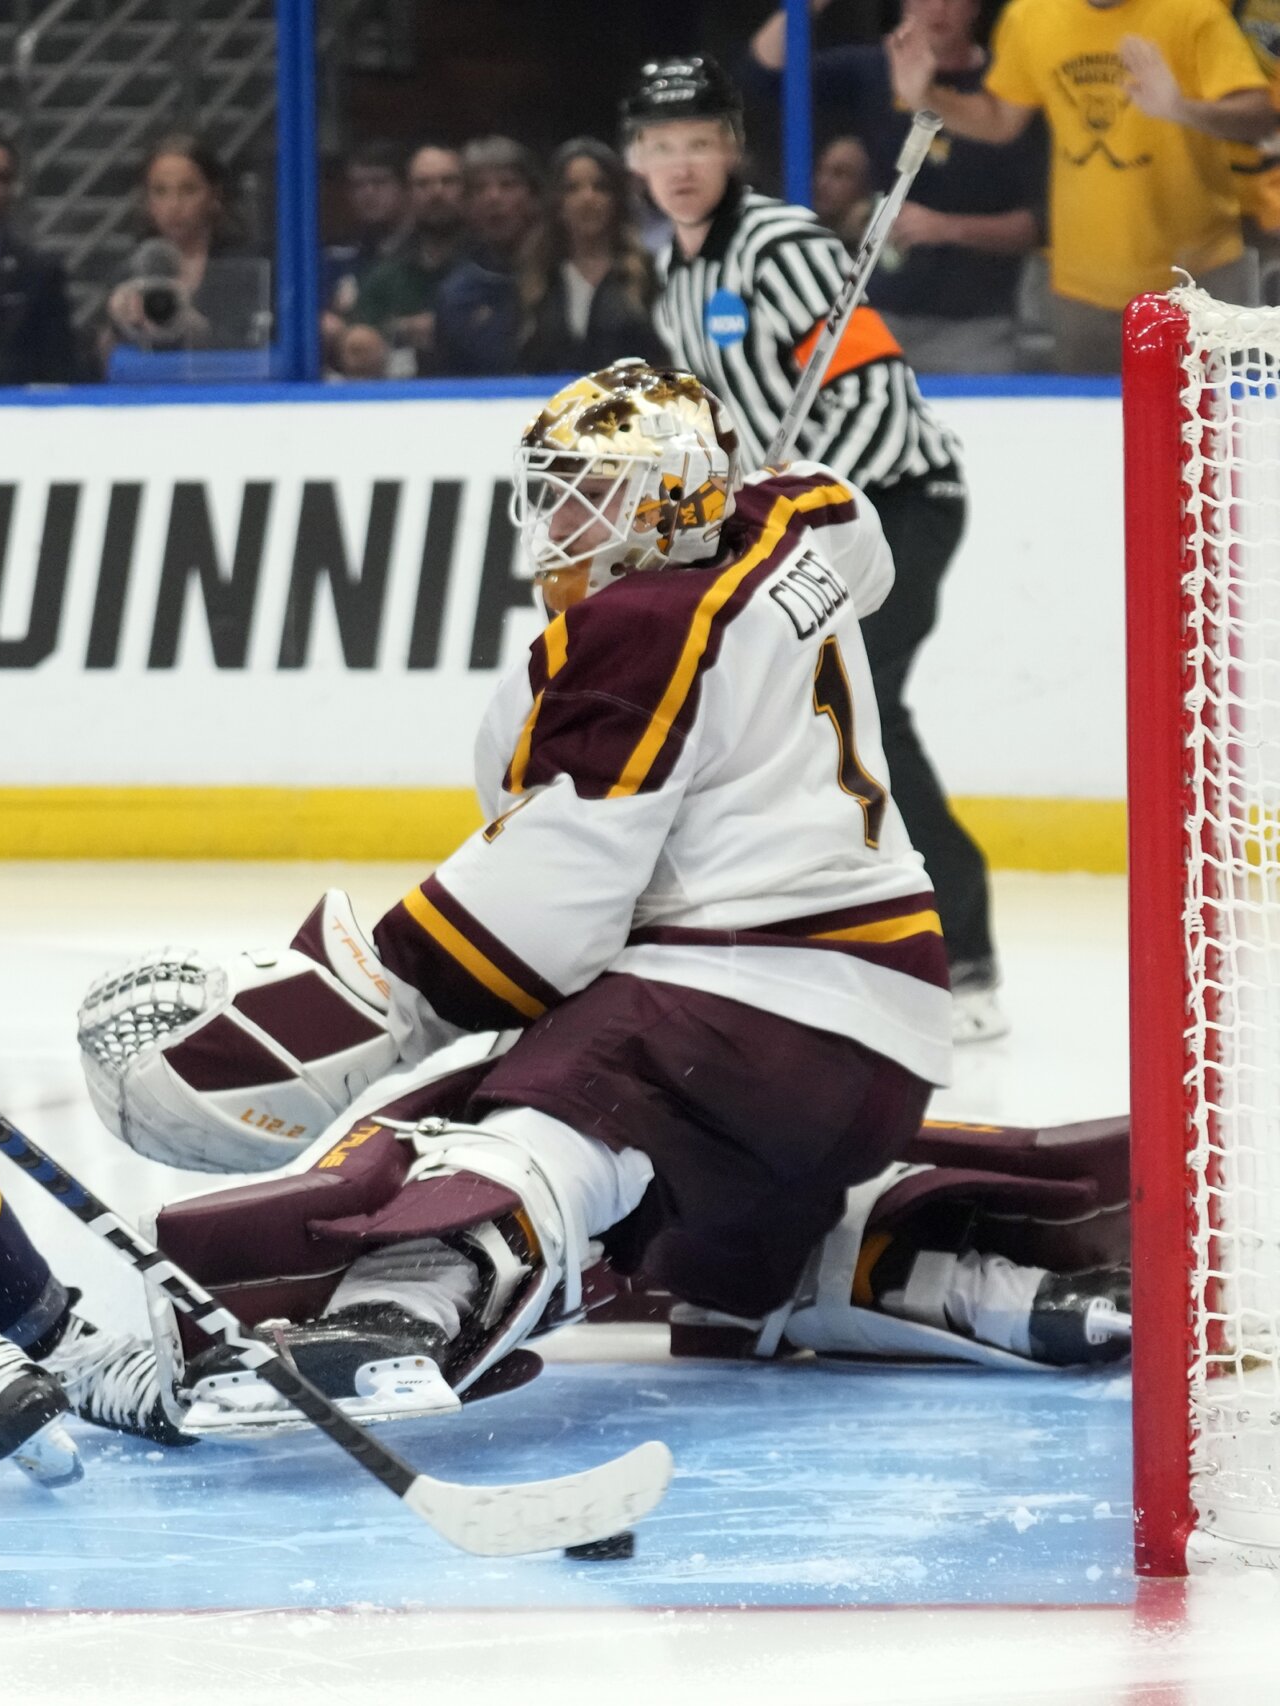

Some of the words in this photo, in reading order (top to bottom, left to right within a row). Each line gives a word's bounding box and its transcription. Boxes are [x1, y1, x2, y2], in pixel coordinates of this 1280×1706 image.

[812, 633, 888, 850] 1
[330, 916, 392, 1001] TRUE
[240, 1108, 307, 1139] L12.2
[318, 1125, 383, 1169] TRUE
[88, 1211, 280, 1370] CCM
